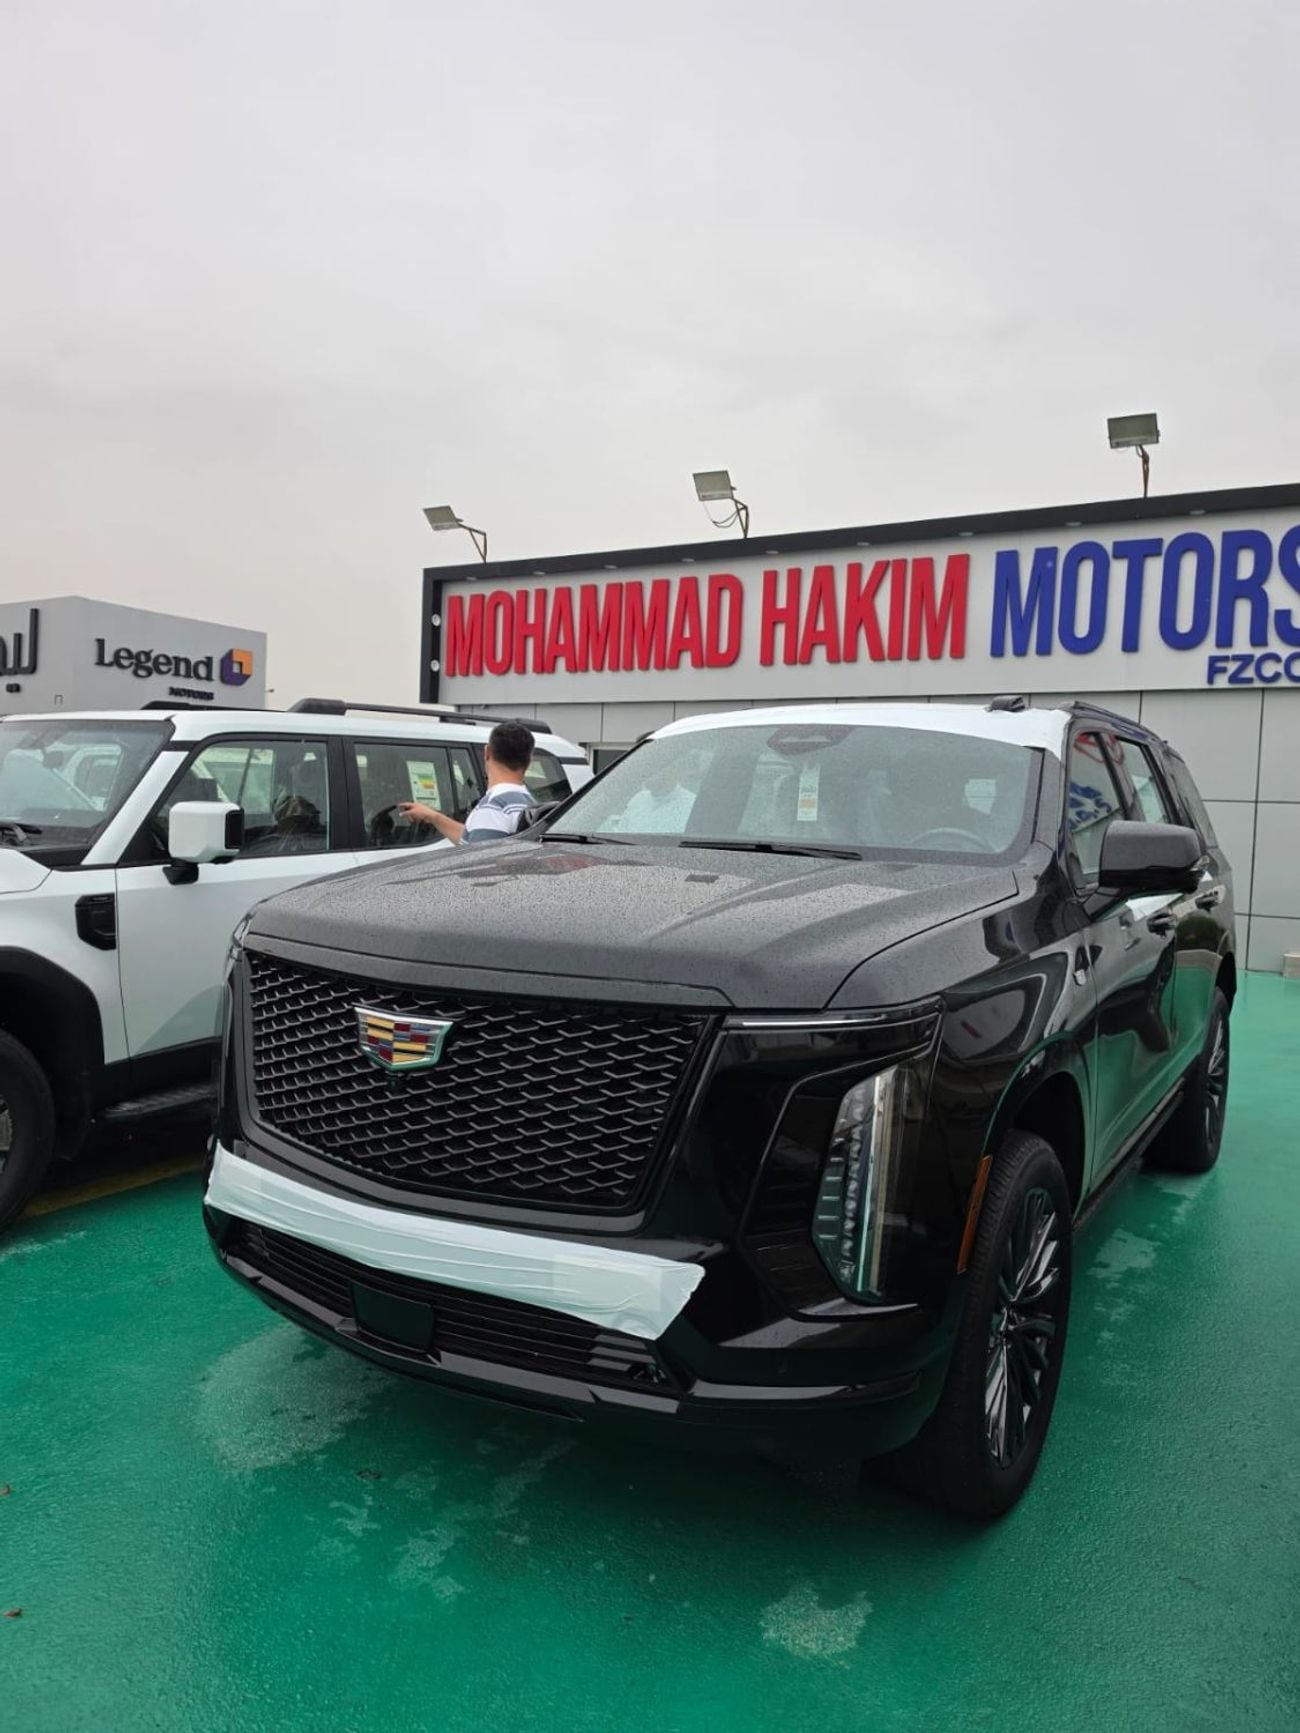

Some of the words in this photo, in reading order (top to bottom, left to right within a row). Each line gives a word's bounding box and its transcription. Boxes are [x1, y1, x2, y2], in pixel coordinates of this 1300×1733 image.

[445, 573, 743, 677] MOHAMMAD
[760, 554, 970, 666] HAKIM
[95, 638, 214, 682] Legend
